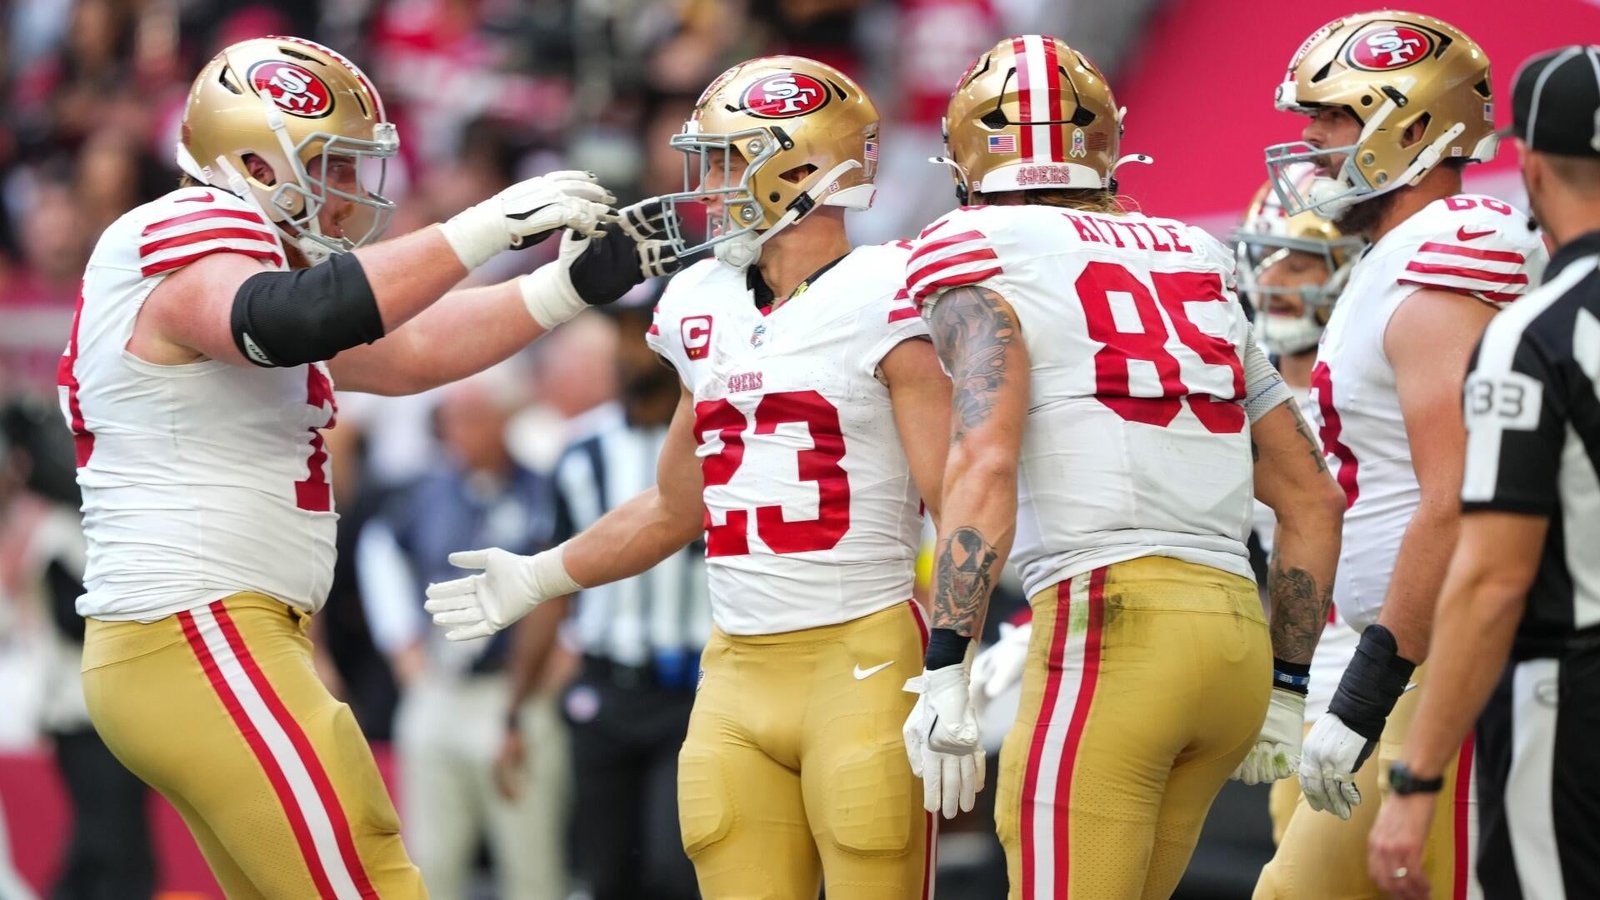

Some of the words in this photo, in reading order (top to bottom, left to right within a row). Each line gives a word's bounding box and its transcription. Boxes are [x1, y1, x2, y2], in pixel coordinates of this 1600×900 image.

[1366, 30, 1420, 66] SF
[269, 67, 320, 108] SF
[763, 77, 817, 113] SF
[1016, 166, 1071, 186] 49ERS
[1062, 213, 1193, 253] KITTLE
[682, 318, 710, 349] C
[1075, 261, 1247, 434] 85
[728, 371, 763, 394] 49ERS
[693, 390, 850, 558] 23
